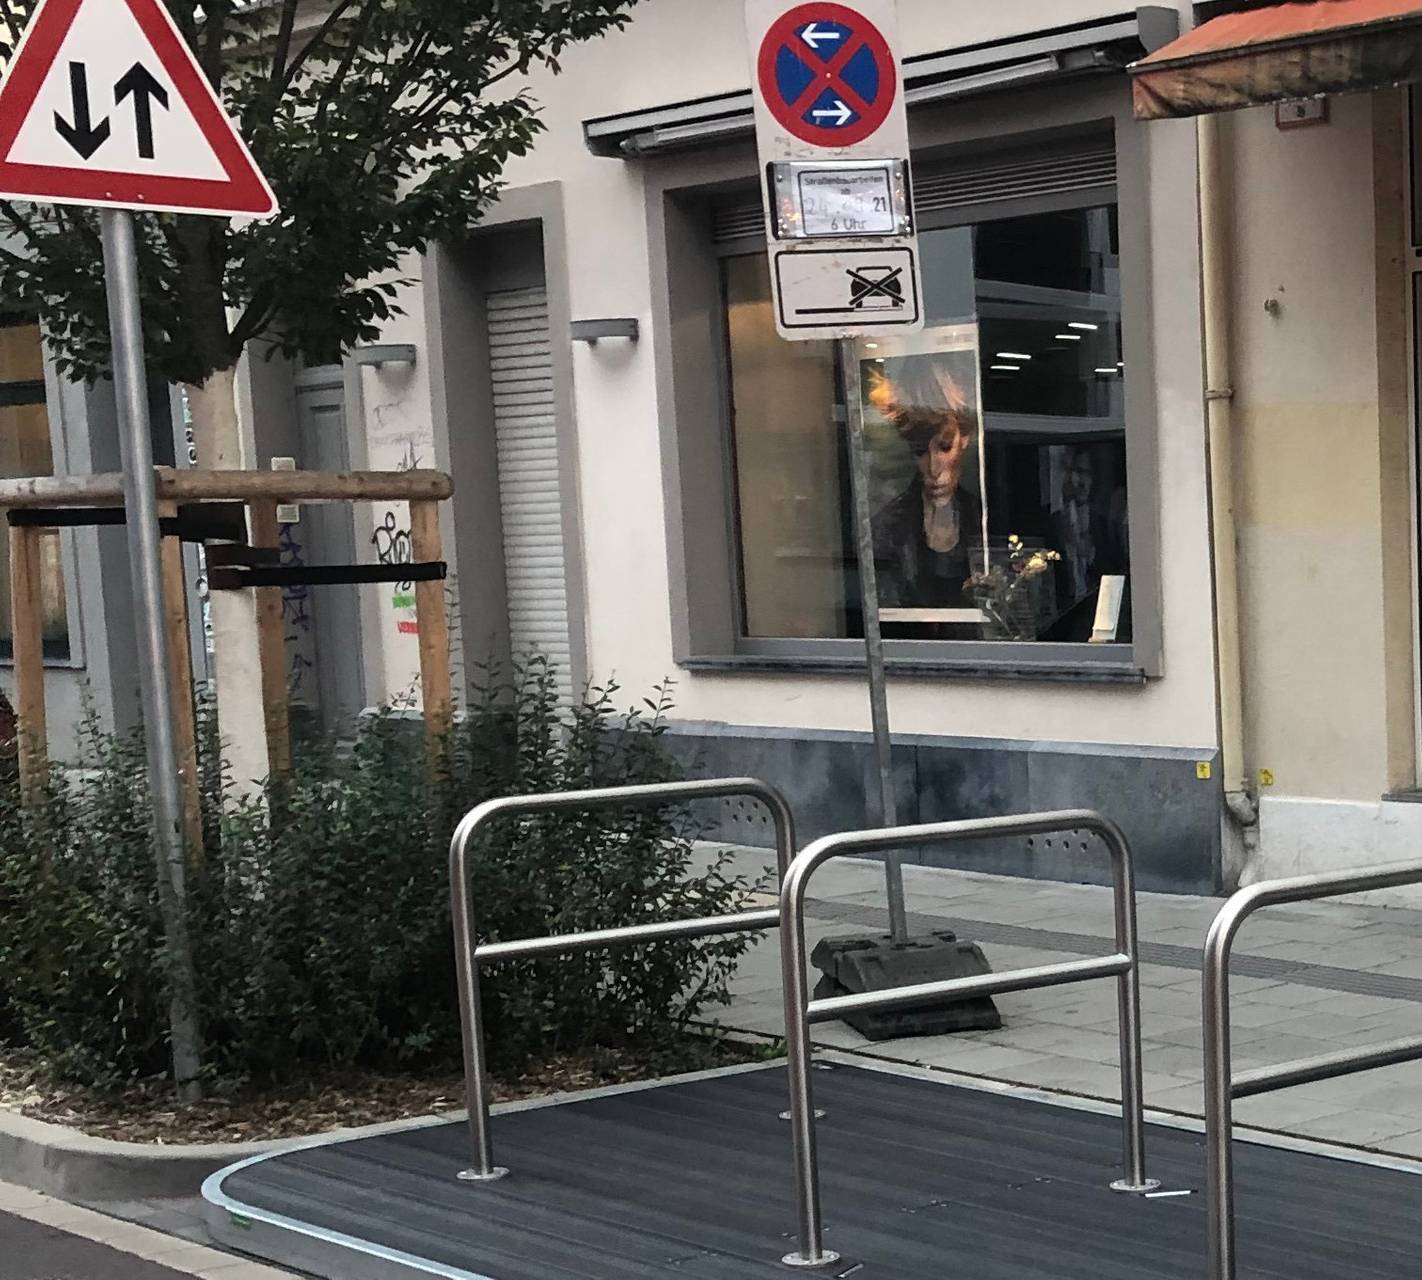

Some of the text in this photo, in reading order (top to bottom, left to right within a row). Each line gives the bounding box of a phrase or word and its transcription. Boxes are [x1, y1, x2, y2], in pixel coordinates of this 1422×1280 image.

[872, 196, 887, 212] 21
[831, 217, 867, 230] 6 Uhr
